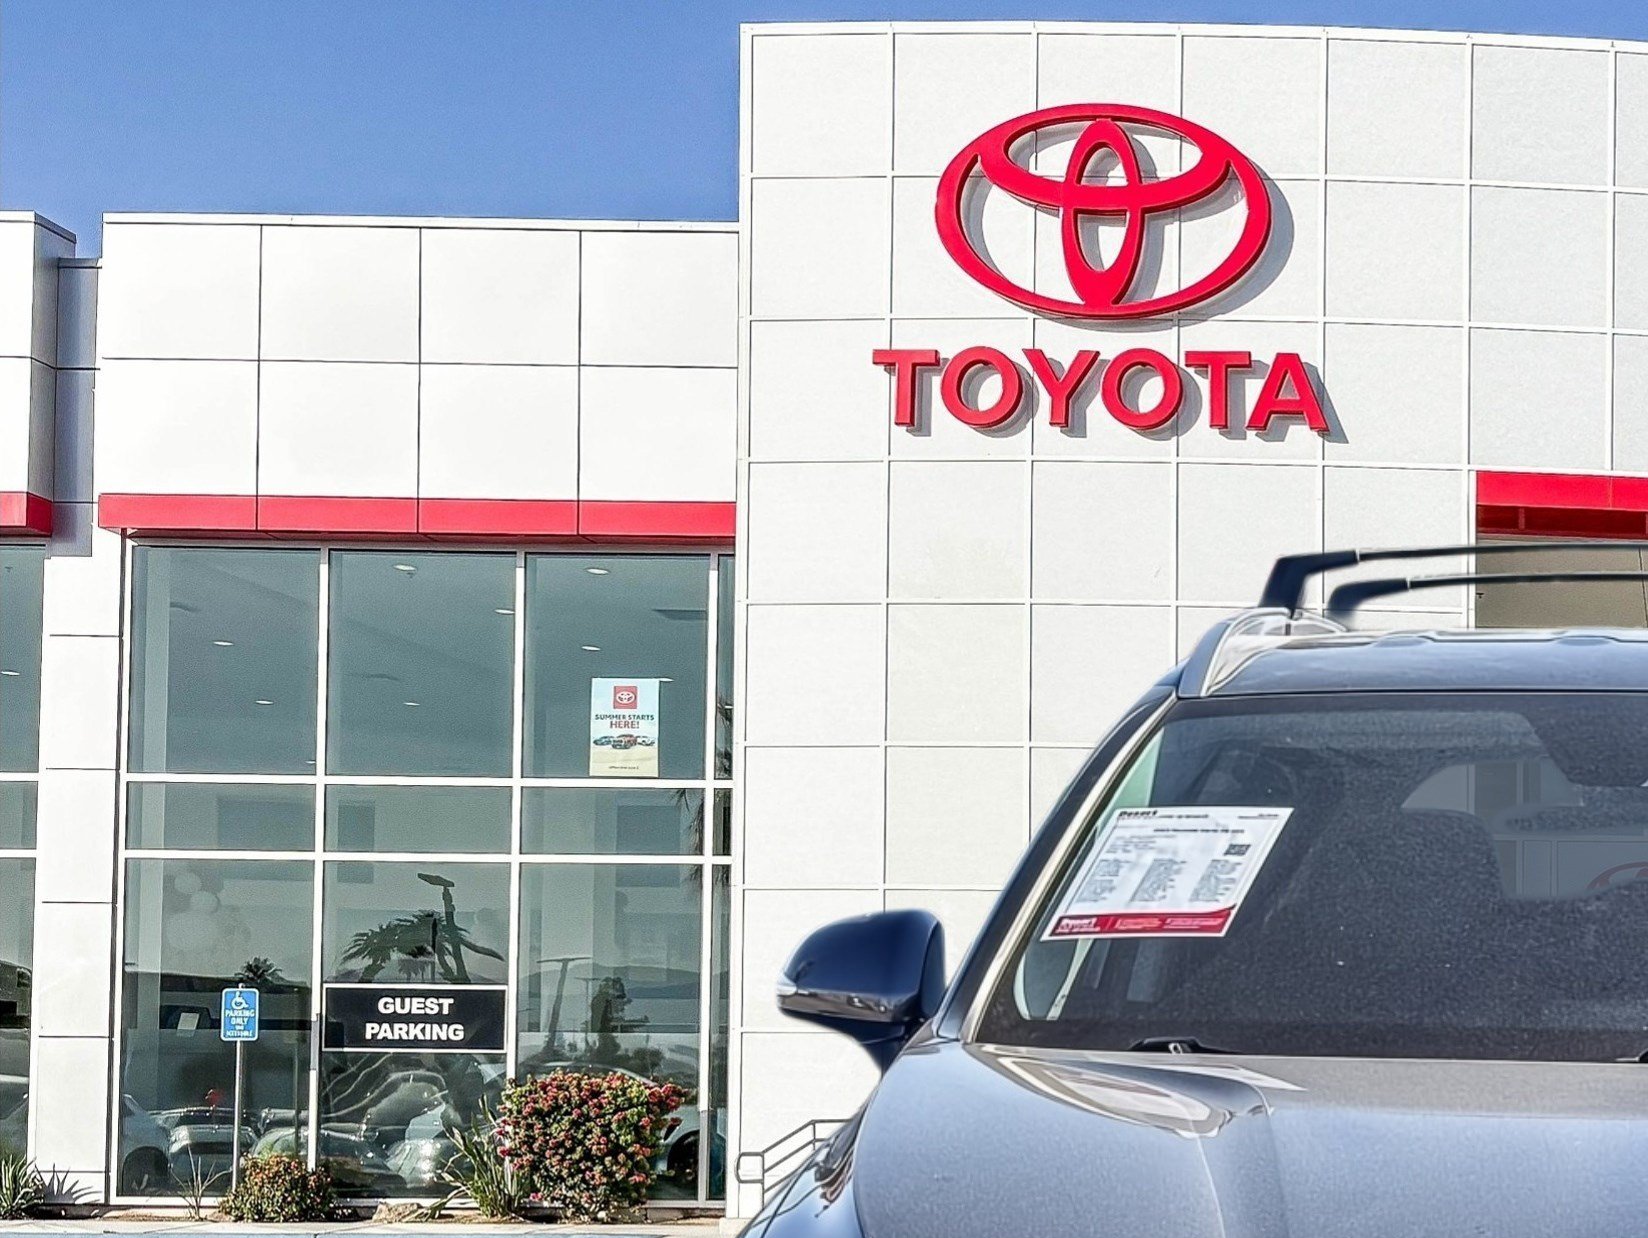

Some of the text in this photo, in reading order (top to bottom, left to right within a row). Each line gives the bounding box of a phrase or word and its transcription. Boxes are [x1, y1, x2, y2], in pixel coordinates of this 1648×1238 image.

[872, 346, 1330, 432] TOYOTA
[610, 721, 640, 729] HERE!
[377, 997, 454, 1015] GUEST
[225, 1009, 255, 1017] PARKING
[231, 1017, 249, 1025] ONLY
[365, 1022, 465, 1041] PARKING
